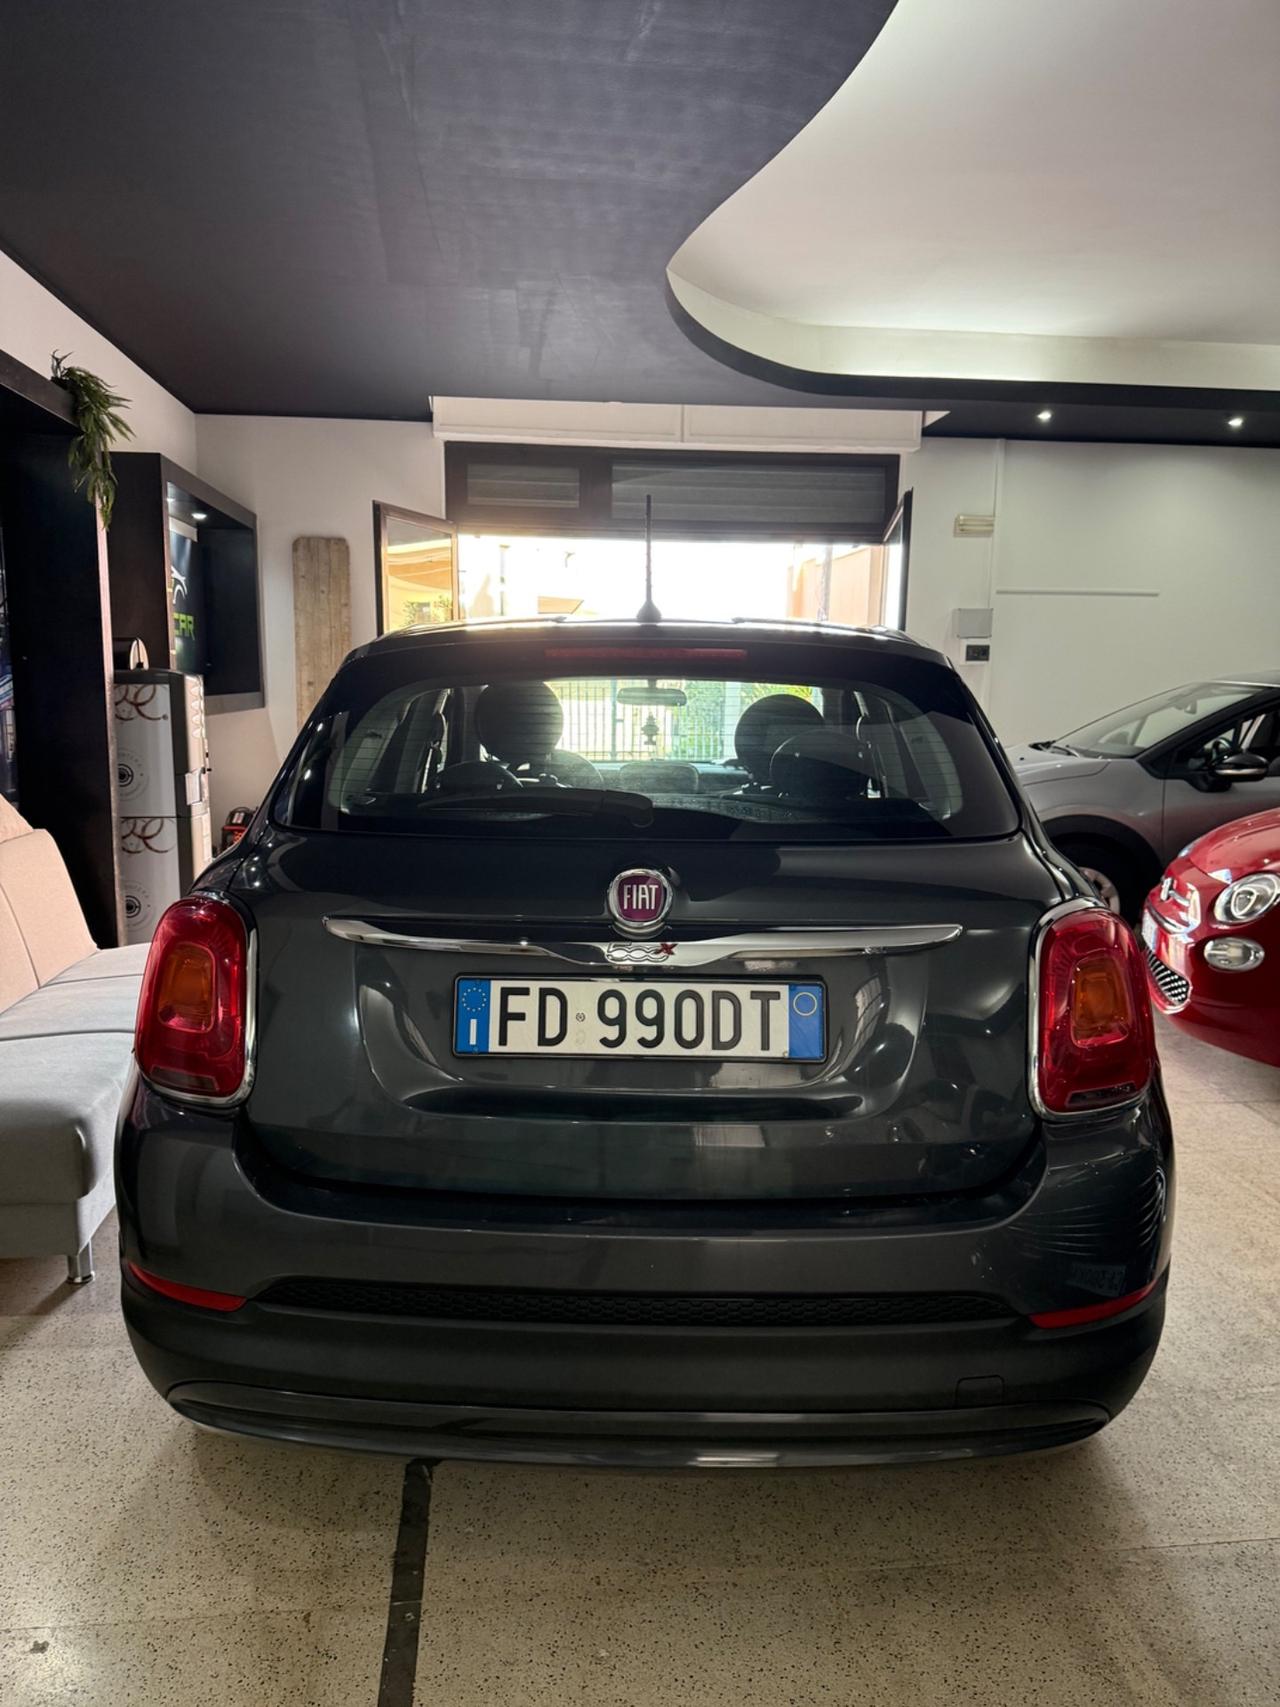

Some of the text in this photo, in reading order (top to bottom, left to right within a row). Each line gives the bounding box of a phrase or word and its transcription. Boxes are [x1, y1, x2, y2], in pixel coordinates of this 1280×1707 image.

[623, 884, 659, 910] FIAT
[469, 1018, 477, 1046] I
[498, 986, 781, 1051] FD 990DT
